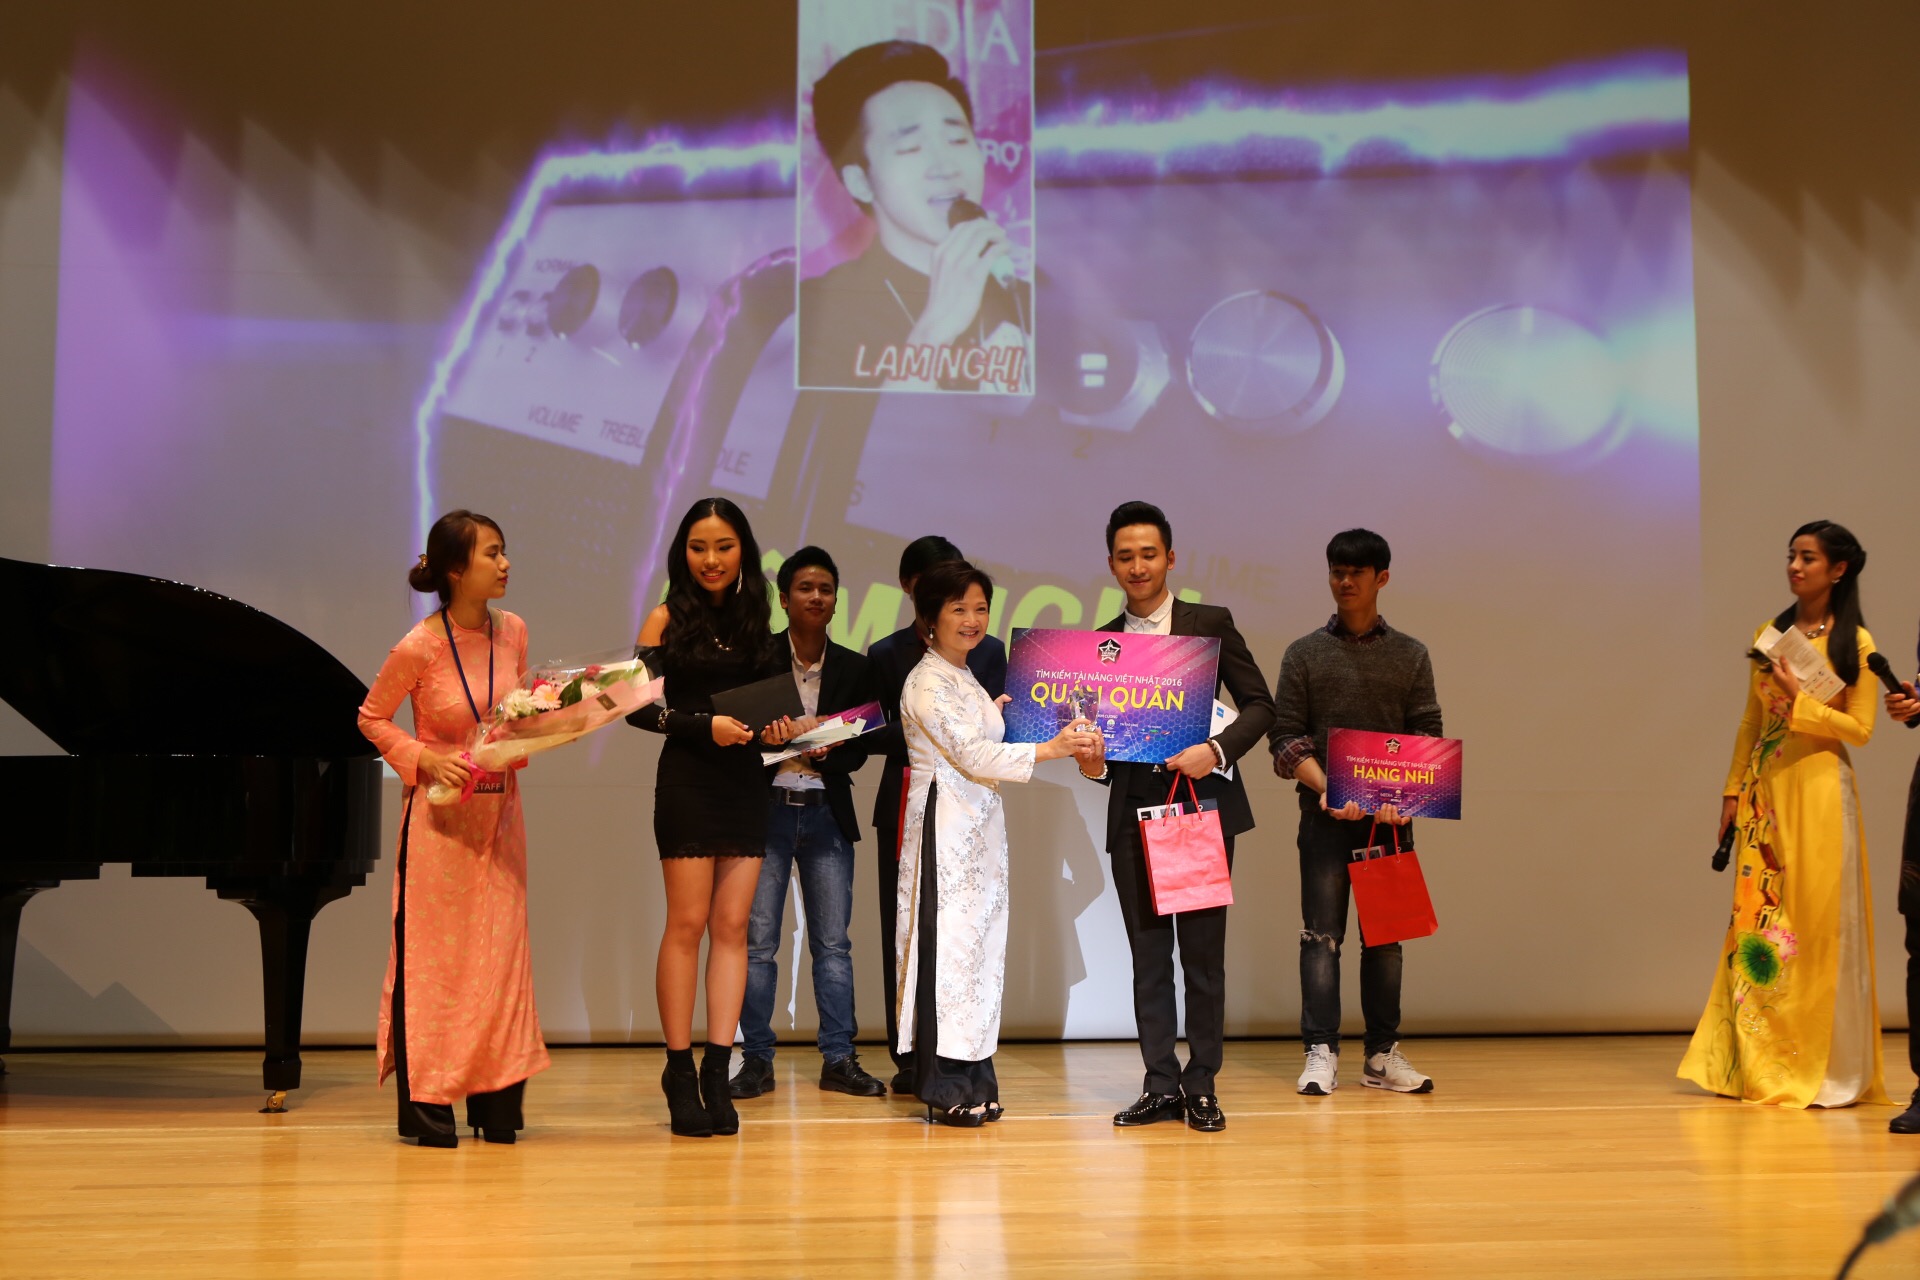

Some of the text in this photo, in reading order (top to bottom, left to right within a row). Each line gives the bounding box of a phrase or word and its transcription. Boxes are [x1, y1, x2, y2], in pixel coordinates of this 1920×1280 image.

[978, 138, 1024, 173] RỢ
[527, 404, 583, 434] VOLUME
[1036, 669, 1050, 679] TÌM
[1051, 669, 1071, 680] KIẾM
[1088, 672, 1113, 683] NĂNG
[1114, 673, 1134, 685] VIỆT
[1135, 675, 1160, 686] NHẬT
[1161, 677, 1183, 687] 2016
[1109, 684, 1185, 713] QUÂN
[1354, 764, 1400, 783] HẠNG
[474, 782, 501, 791] STAFF
